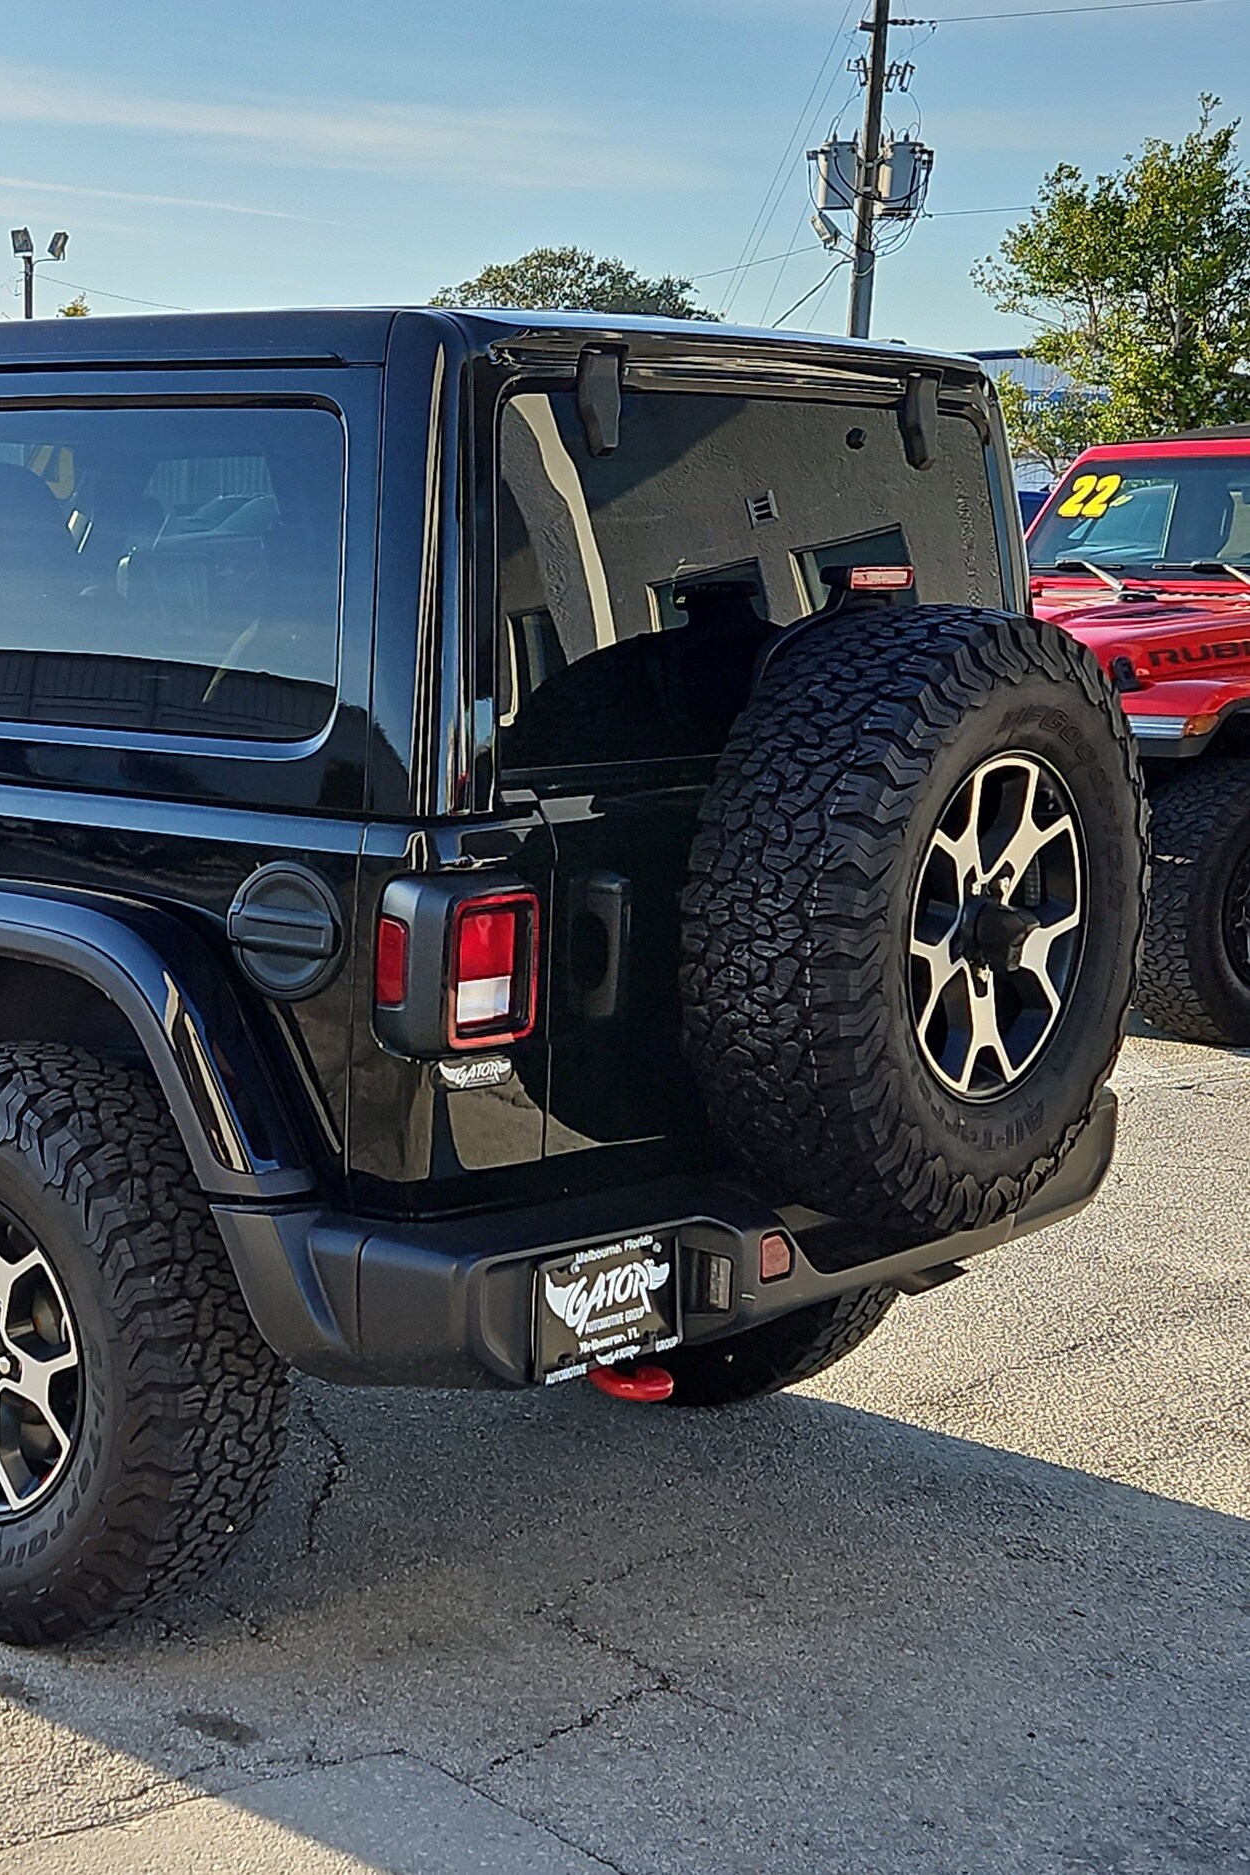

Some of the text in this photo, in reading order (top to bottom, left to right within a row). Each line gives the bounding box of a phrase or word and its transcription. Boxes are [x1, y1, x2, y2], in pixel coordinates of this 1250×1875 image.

[1057, 474, 1122, 518] 22
[455, 1060, 501, 1088] GATOR
[624, 1235, 654, 1253] Florida
[564, 1260, 652, 1338] GATOR
[585, 1306, 646, 1334] AUTOMOTIVE GROUP
[655, 1336, 679, 1353] GROUP
[545, 1362, 588, 1386] AUTOMOTIVE
